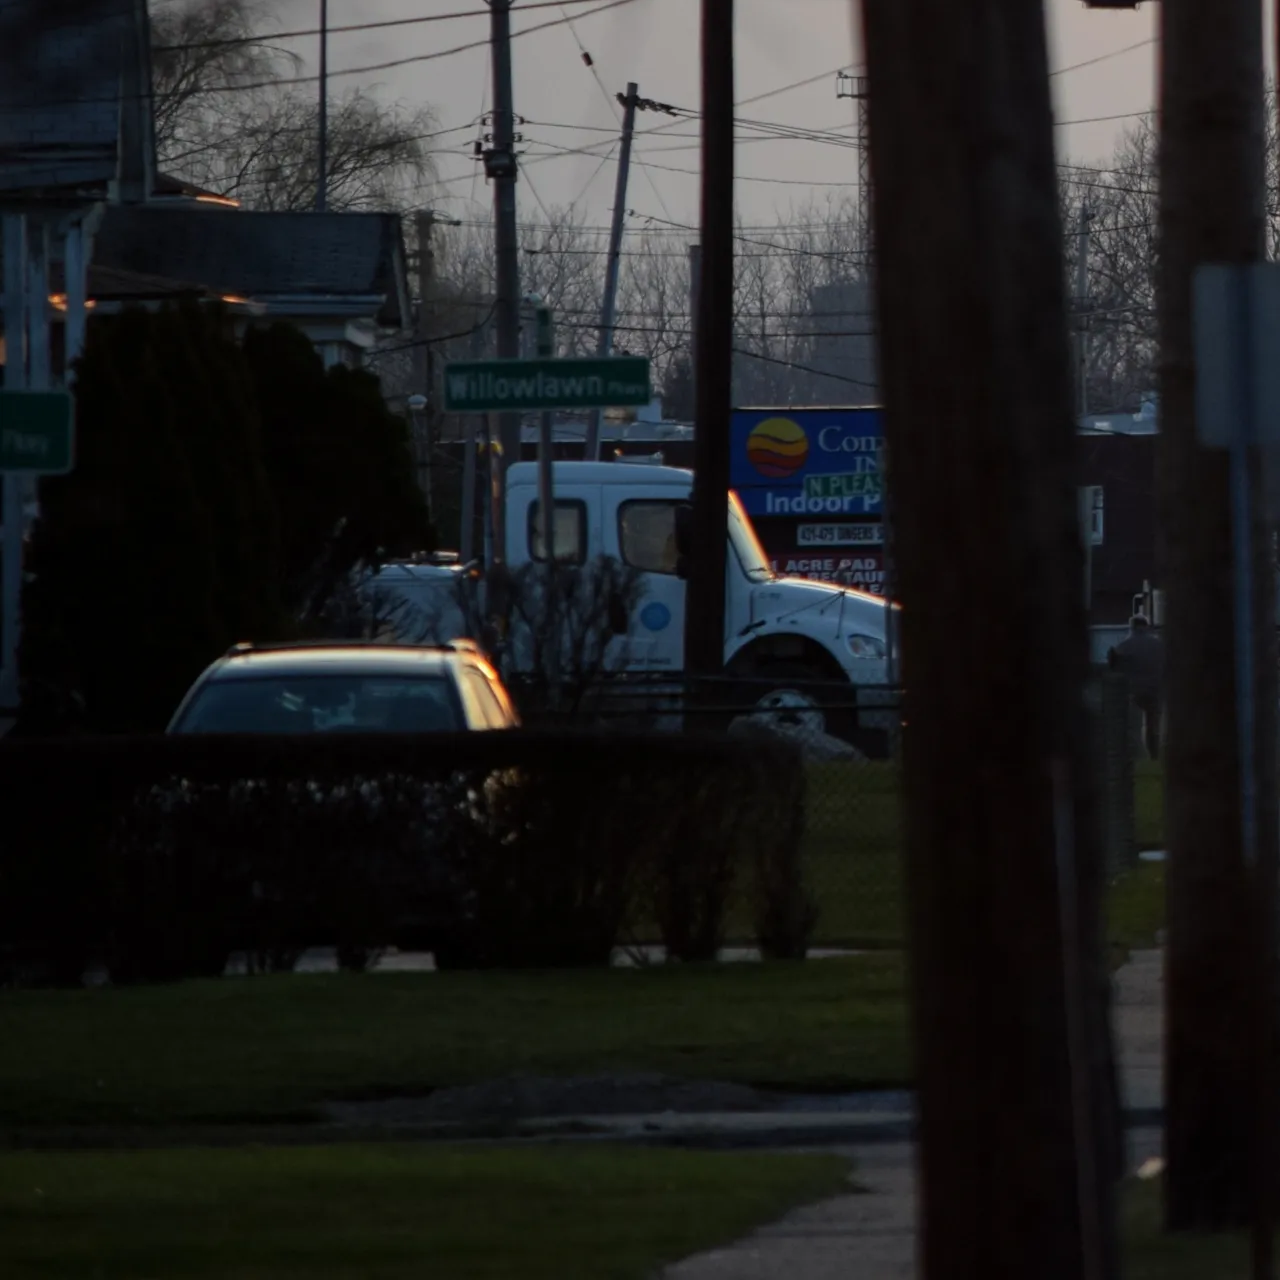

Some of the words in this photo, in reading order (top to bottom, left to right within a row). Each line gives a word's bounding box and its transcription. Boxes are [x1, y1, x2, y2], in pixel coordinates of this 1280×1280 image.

[450, 371, 603, 400] Willowlawn
[766, 492, 855, 513] Indoor
[785, 559, 834, 570] ACRE
[838, 558, 876, 570] PAD
